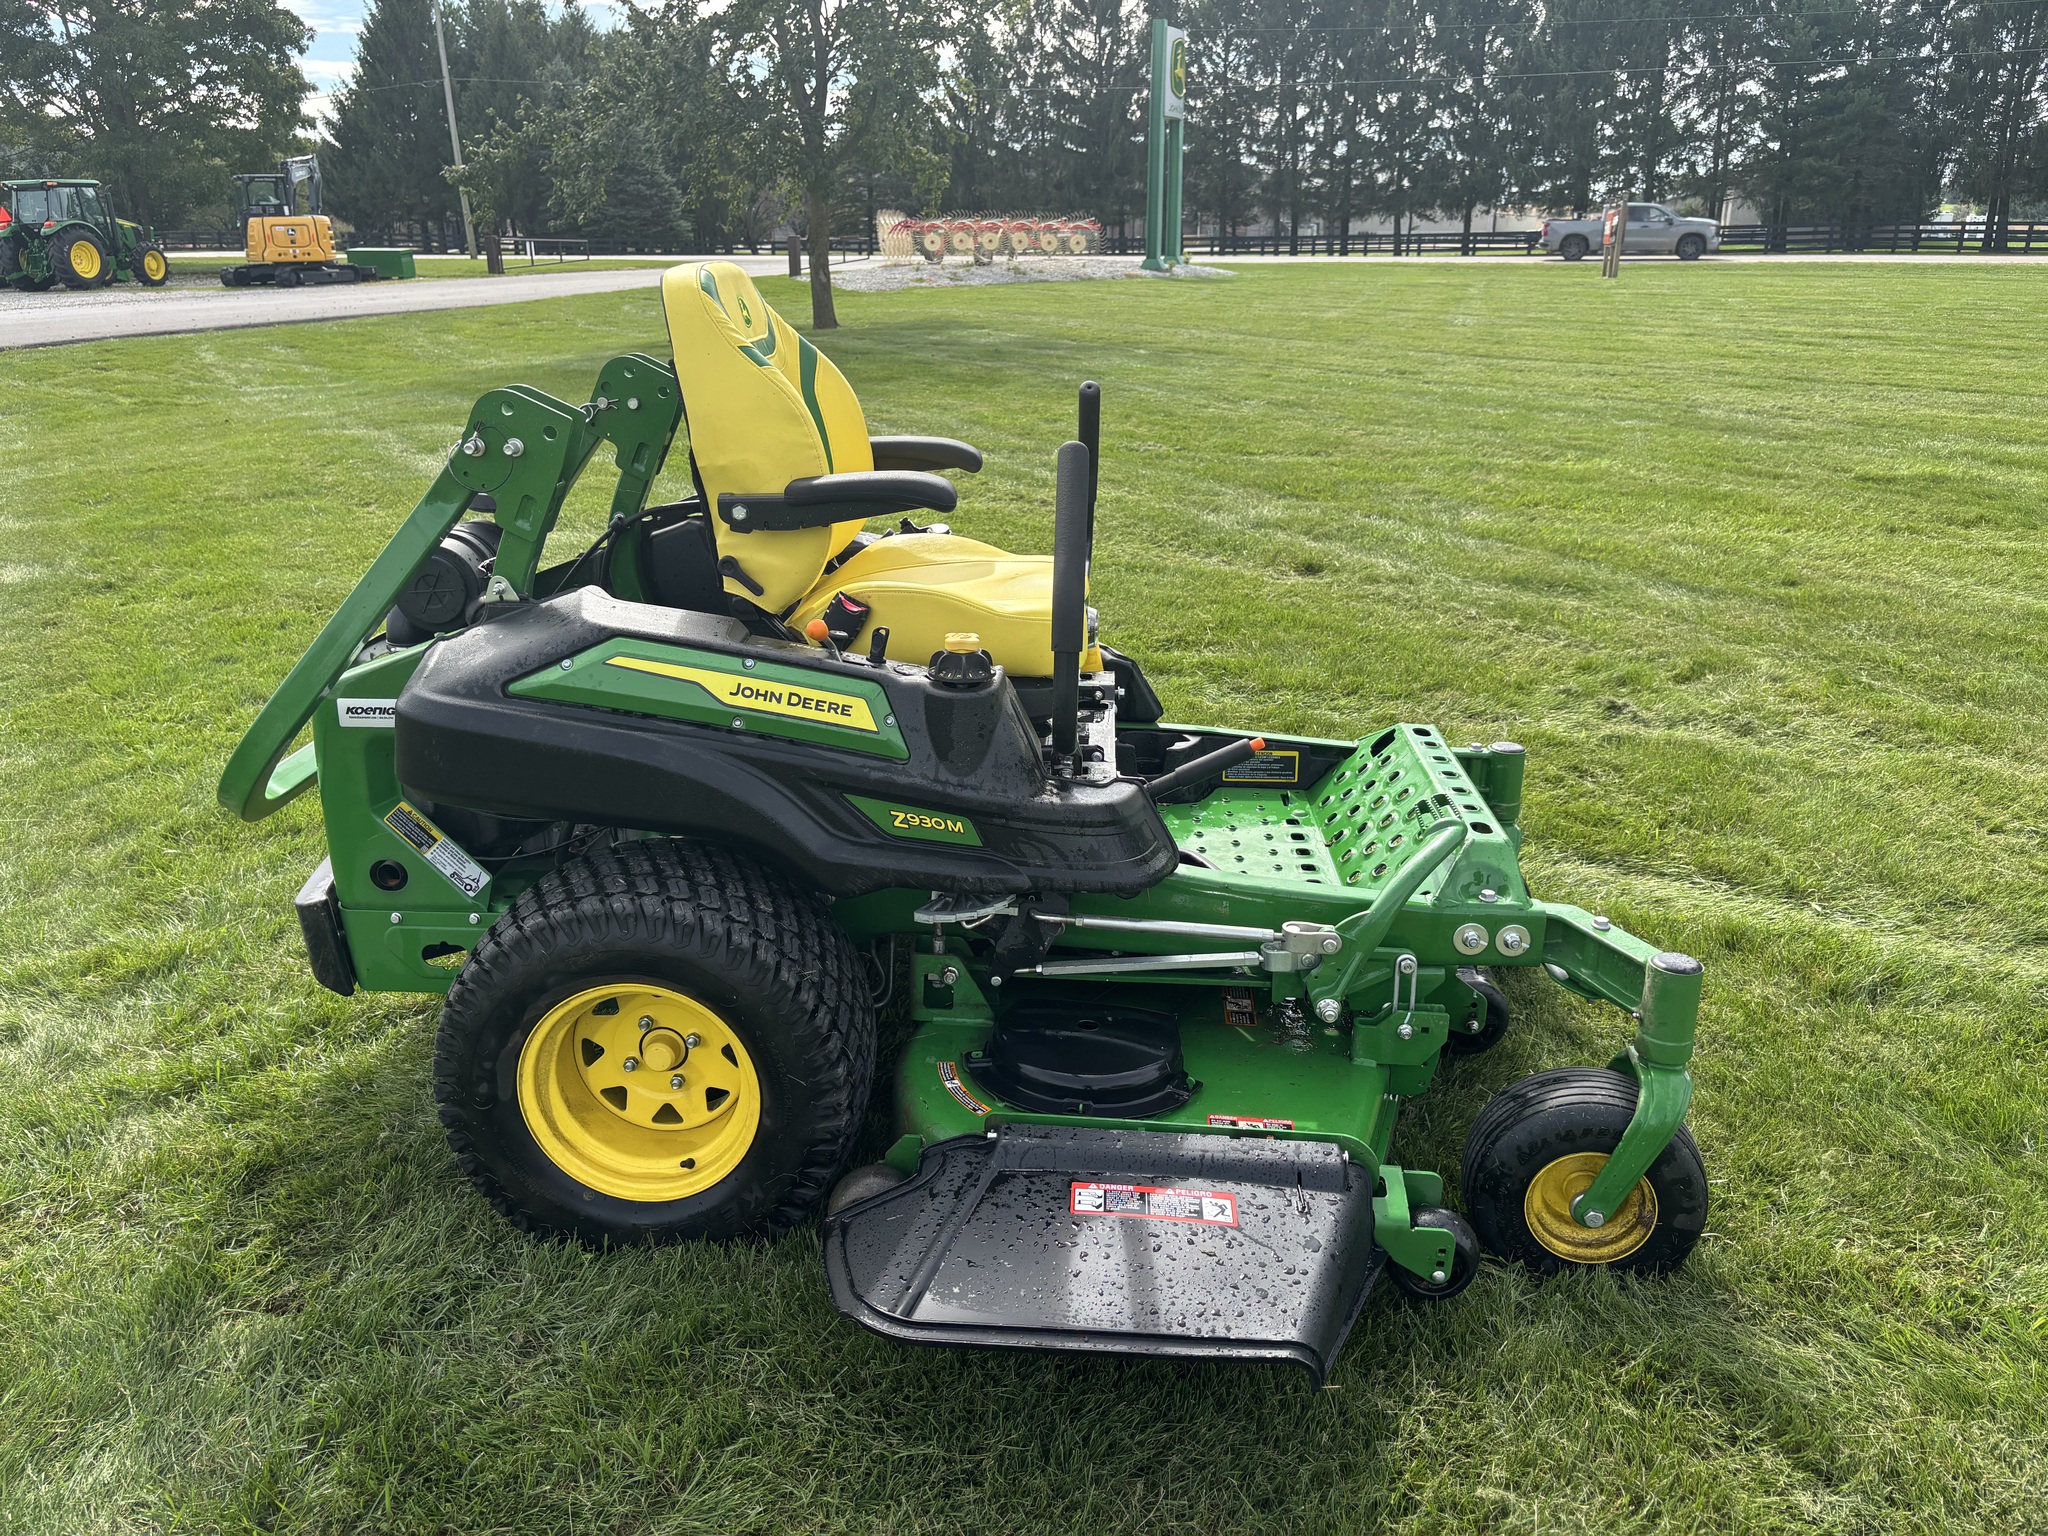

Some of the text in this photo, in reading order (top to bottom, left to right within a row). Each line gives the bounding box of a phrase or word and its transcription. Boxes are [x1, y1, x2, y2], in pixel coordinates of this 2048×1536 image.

[729, 682, 853, 717] JOHN DEERE
[411, 812, 434, 833] CAUTION
[889, 810, 964, 833] Z930M
[1099, 1183, 1134, 1191] DANGER
[1175, 1189, 1213, 1197] PELIGRO
